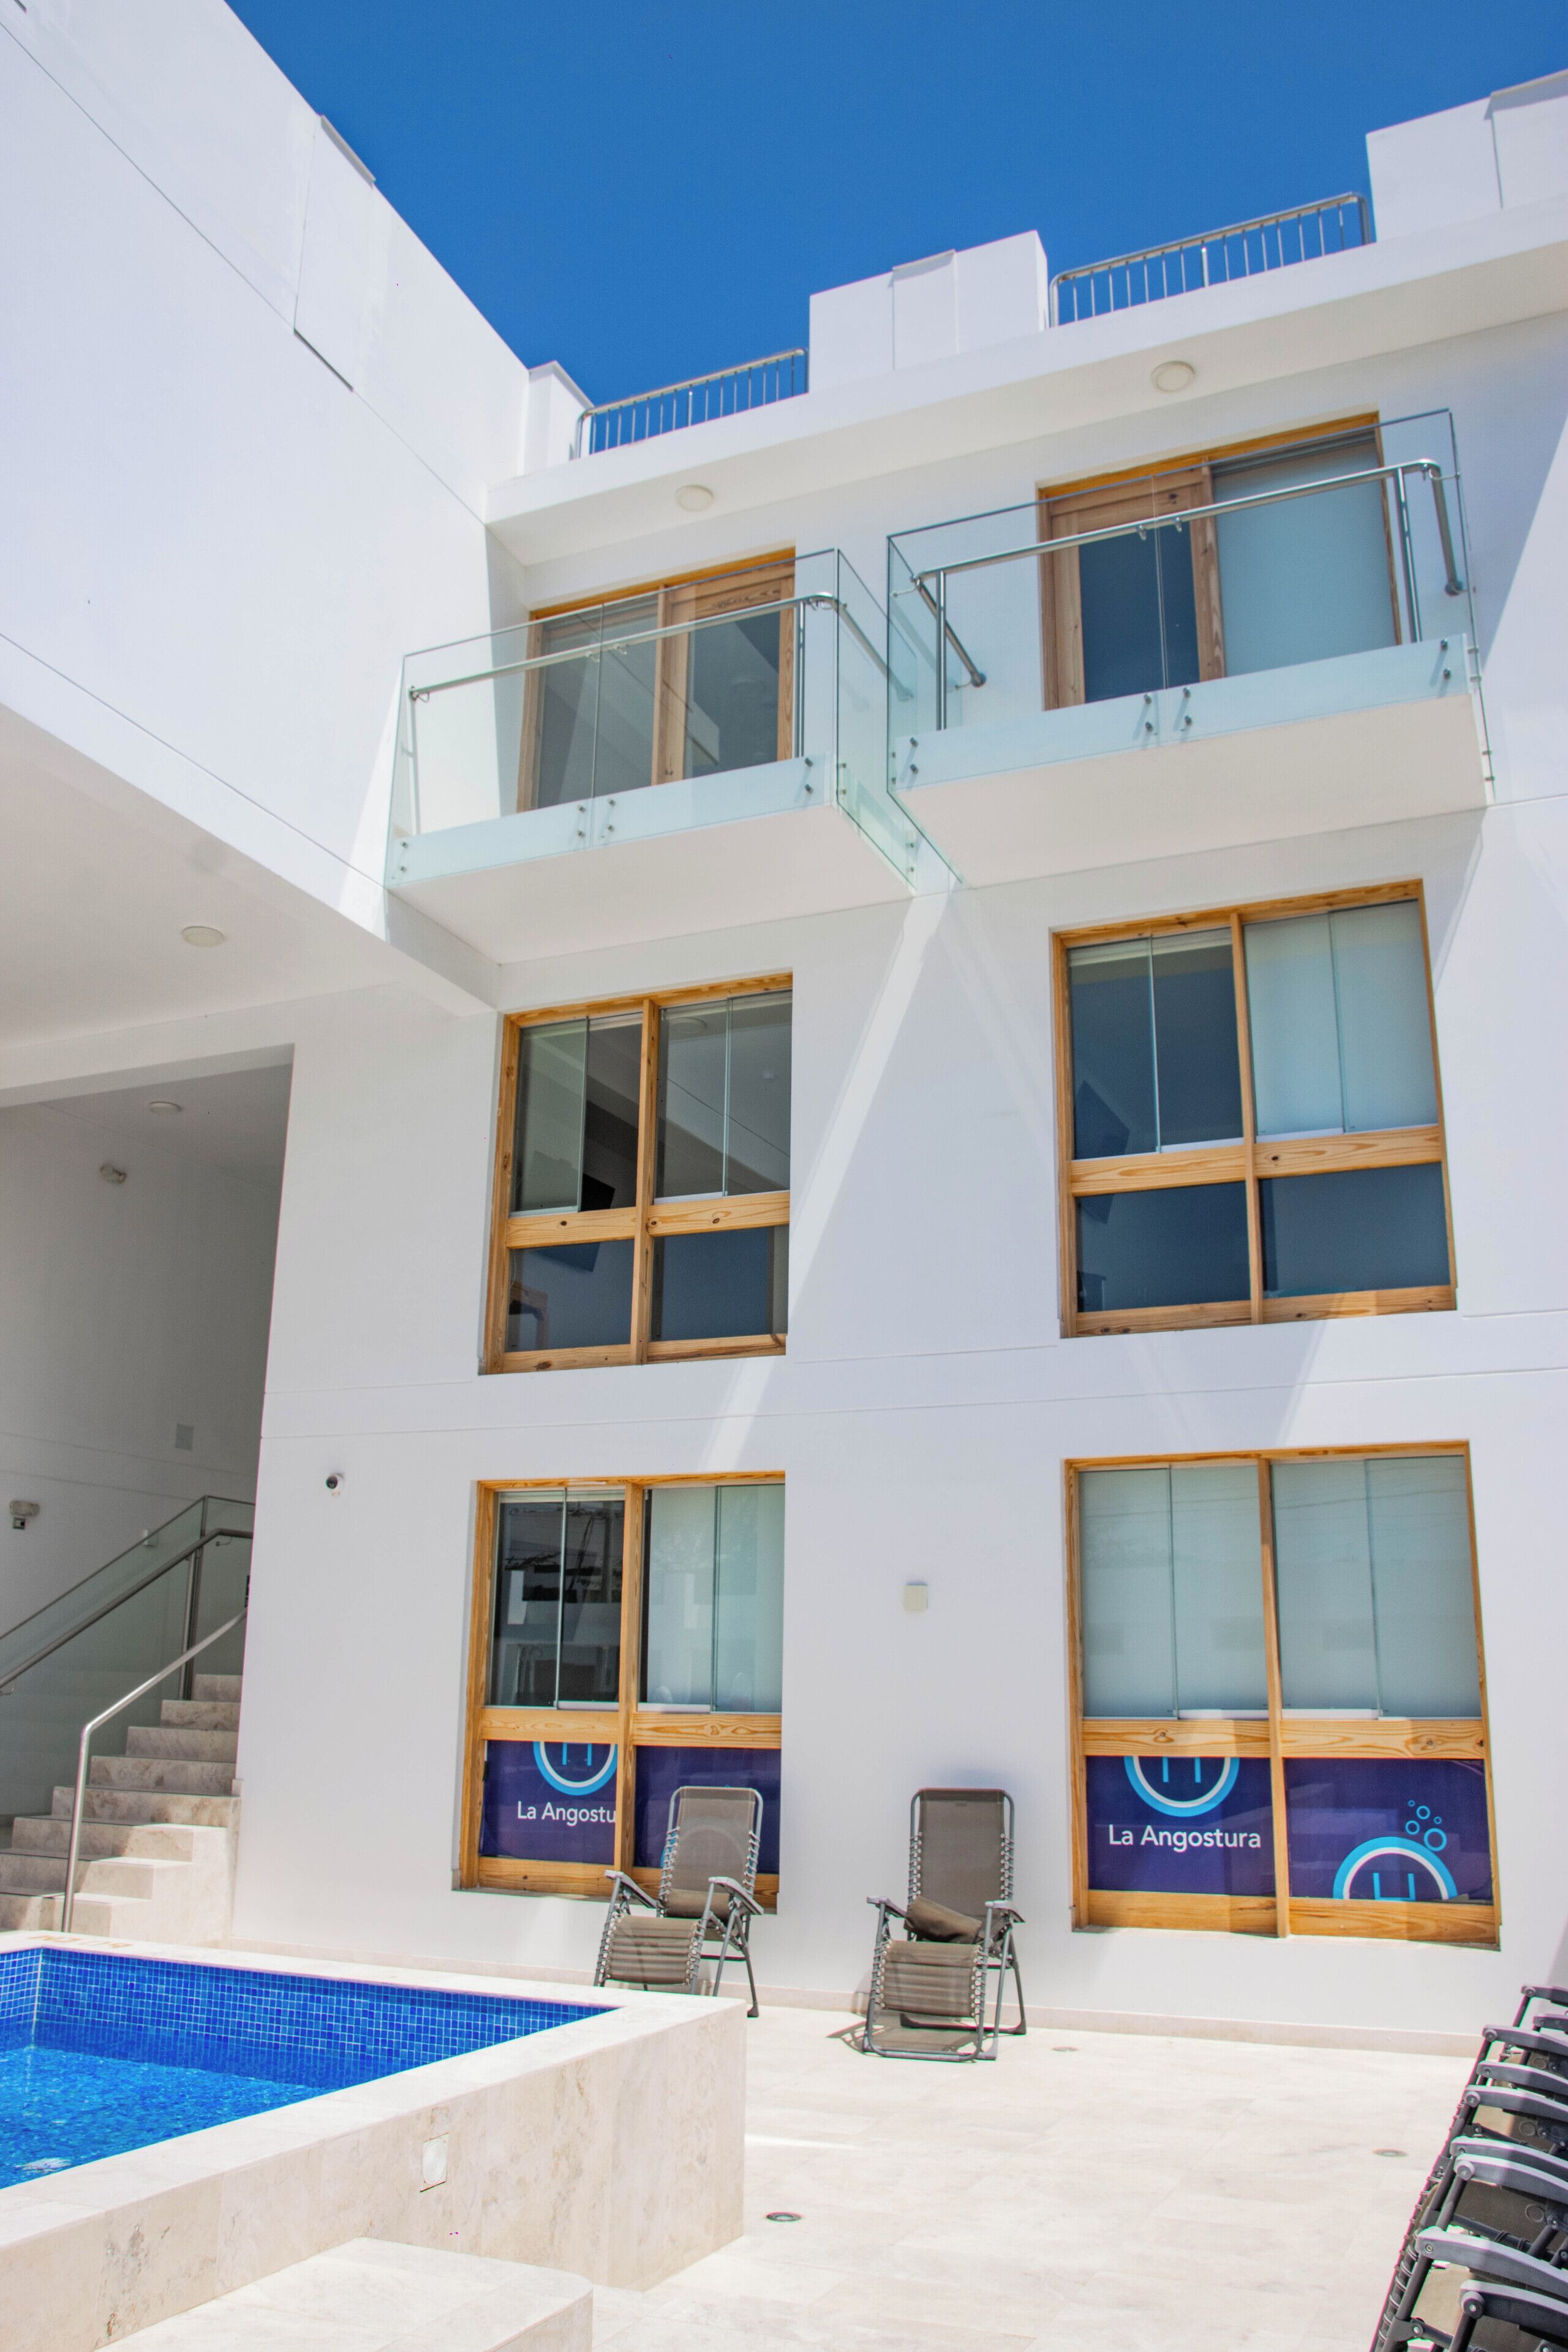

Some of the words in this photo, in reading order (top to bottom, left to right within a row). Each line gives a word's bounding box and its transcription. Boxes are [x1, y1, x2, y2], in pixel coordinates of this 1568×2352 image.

[518, 1801, 537, 1820] La
[1109, 1824, 1133, 1845] La
[1140, 1825, 1261, 1852] Angostura
